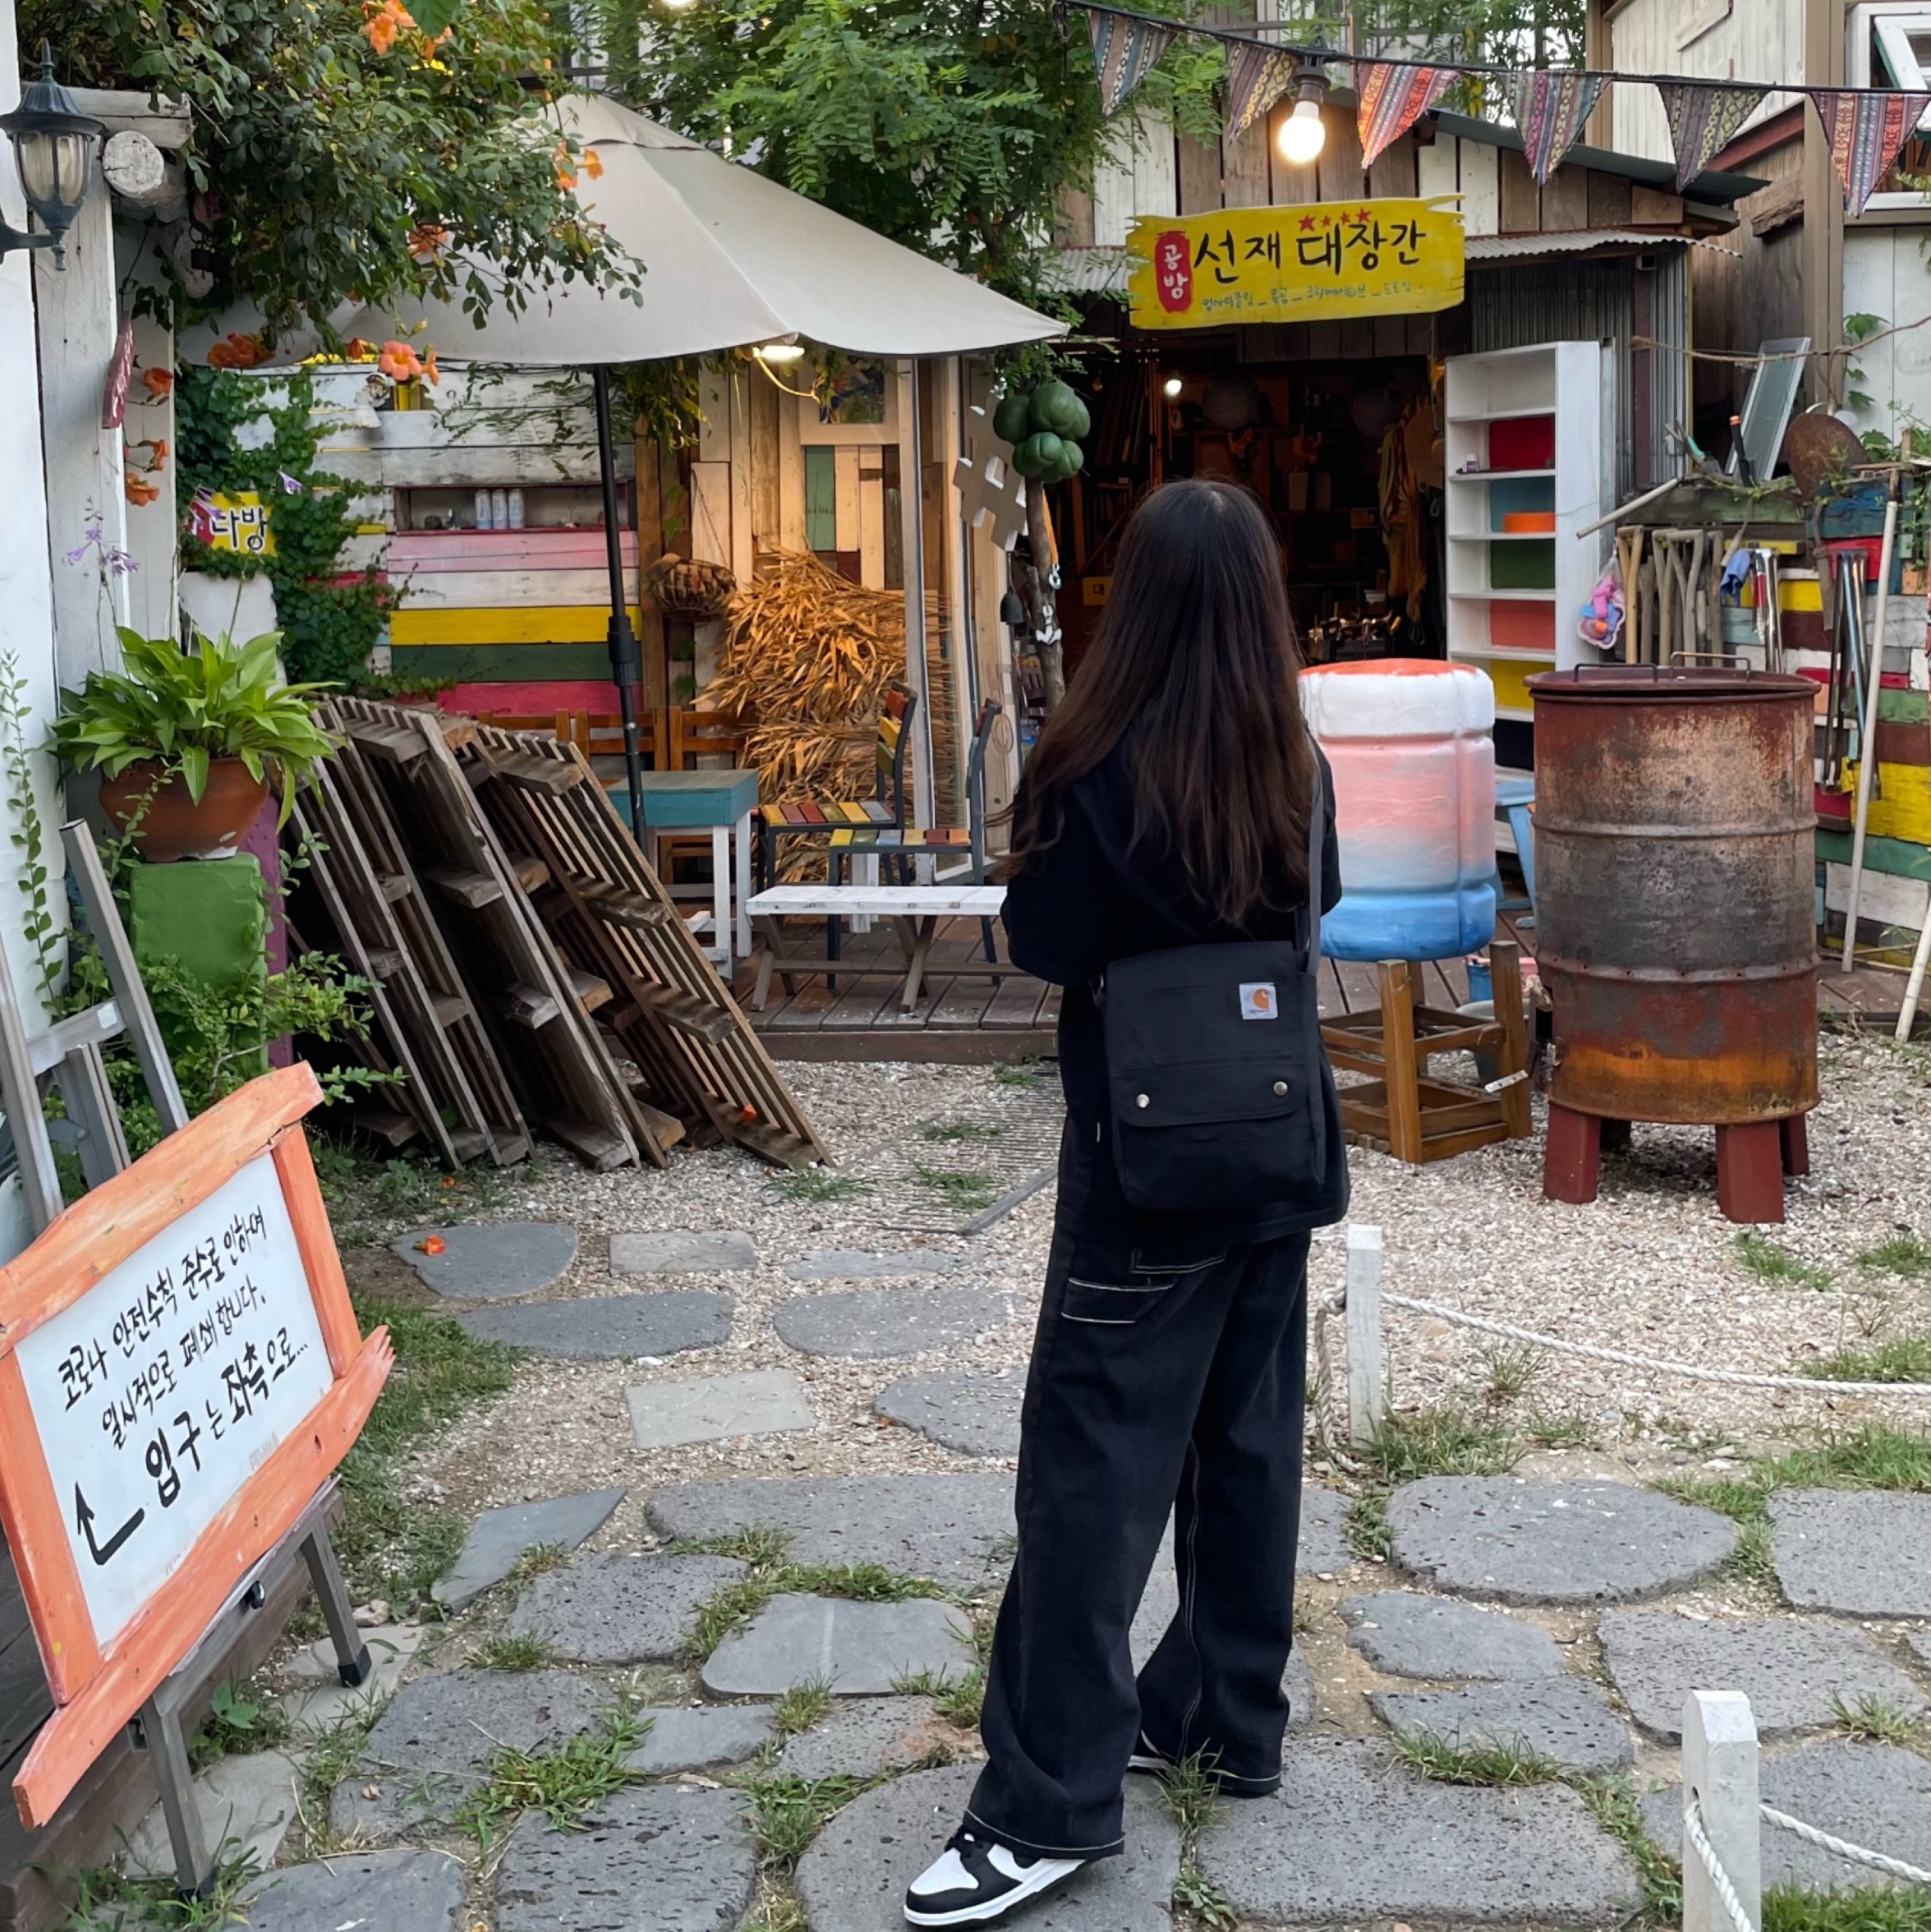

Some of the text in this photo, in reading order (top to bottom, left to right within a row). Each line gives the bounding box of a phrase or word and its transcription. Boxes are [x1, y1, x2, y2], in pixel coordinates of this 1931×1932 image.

[1163, 243, 1189, 300] 공방
[1193, 219, 1427, 284] 선재 대장간
[58, 1337, 108, 1412] 코로나
[113, 1267, 178, 1359] 안전수칙
[182, 1236, 225, 1301] 준수로
[103, 1350, 177, 1451] 일시적으로
